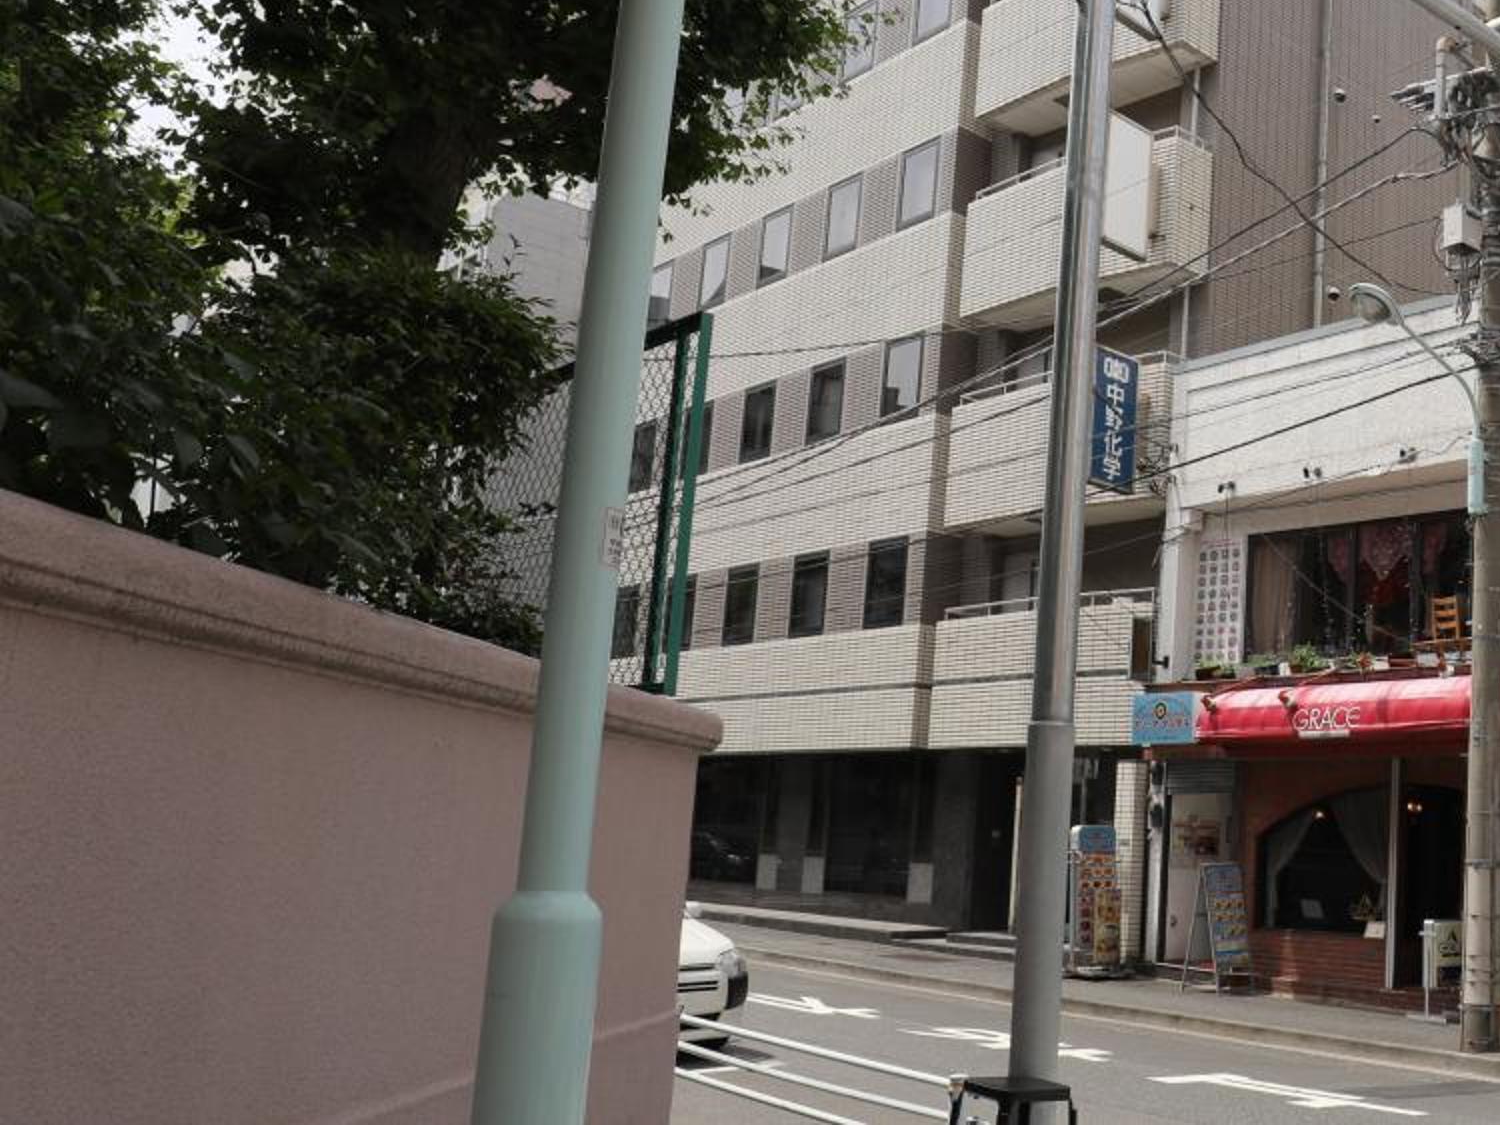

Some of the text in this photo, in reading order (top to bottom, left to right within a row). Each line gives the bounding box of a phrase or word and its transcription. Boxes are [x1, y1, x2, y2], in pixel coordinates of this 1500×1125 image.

[1103, 382, 1125, 481] 中野化学
[1292, 705, 1361, 730] GRACE
